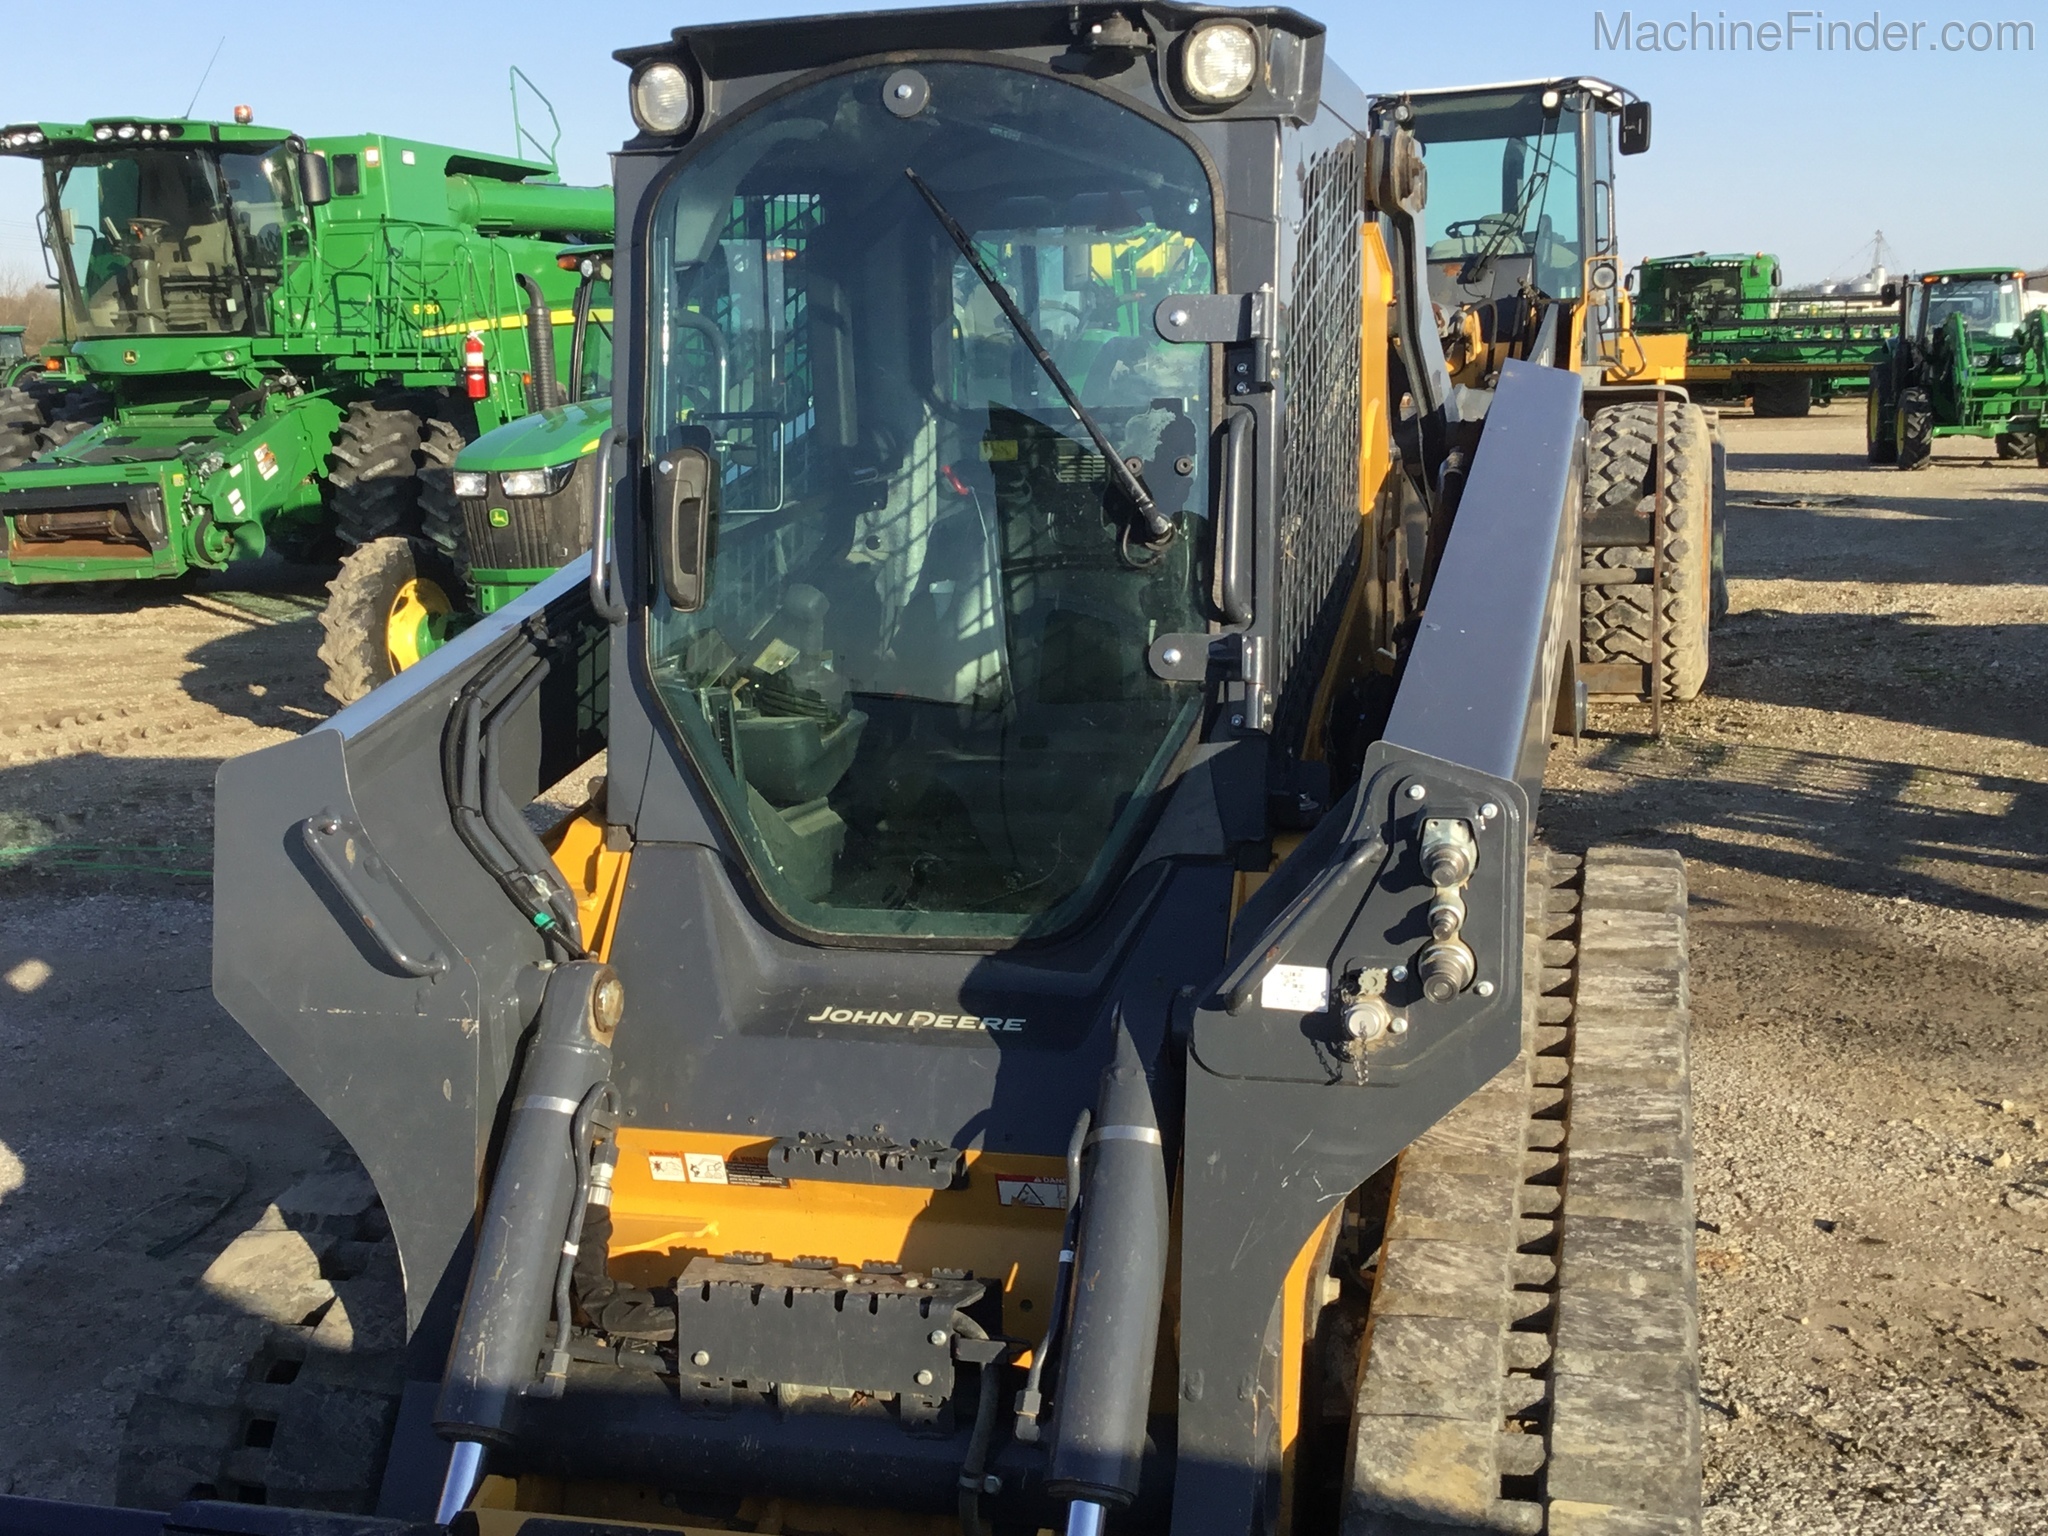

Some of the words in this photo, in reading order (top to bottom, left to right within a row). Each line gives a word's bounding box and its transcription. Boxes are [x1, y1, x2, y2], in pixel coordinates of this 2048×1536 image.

[413, 304, 440, 315] S90
[808, 1006, 903, 1026] JOHN
[907, 1010, 1027, 1032] DEERE
